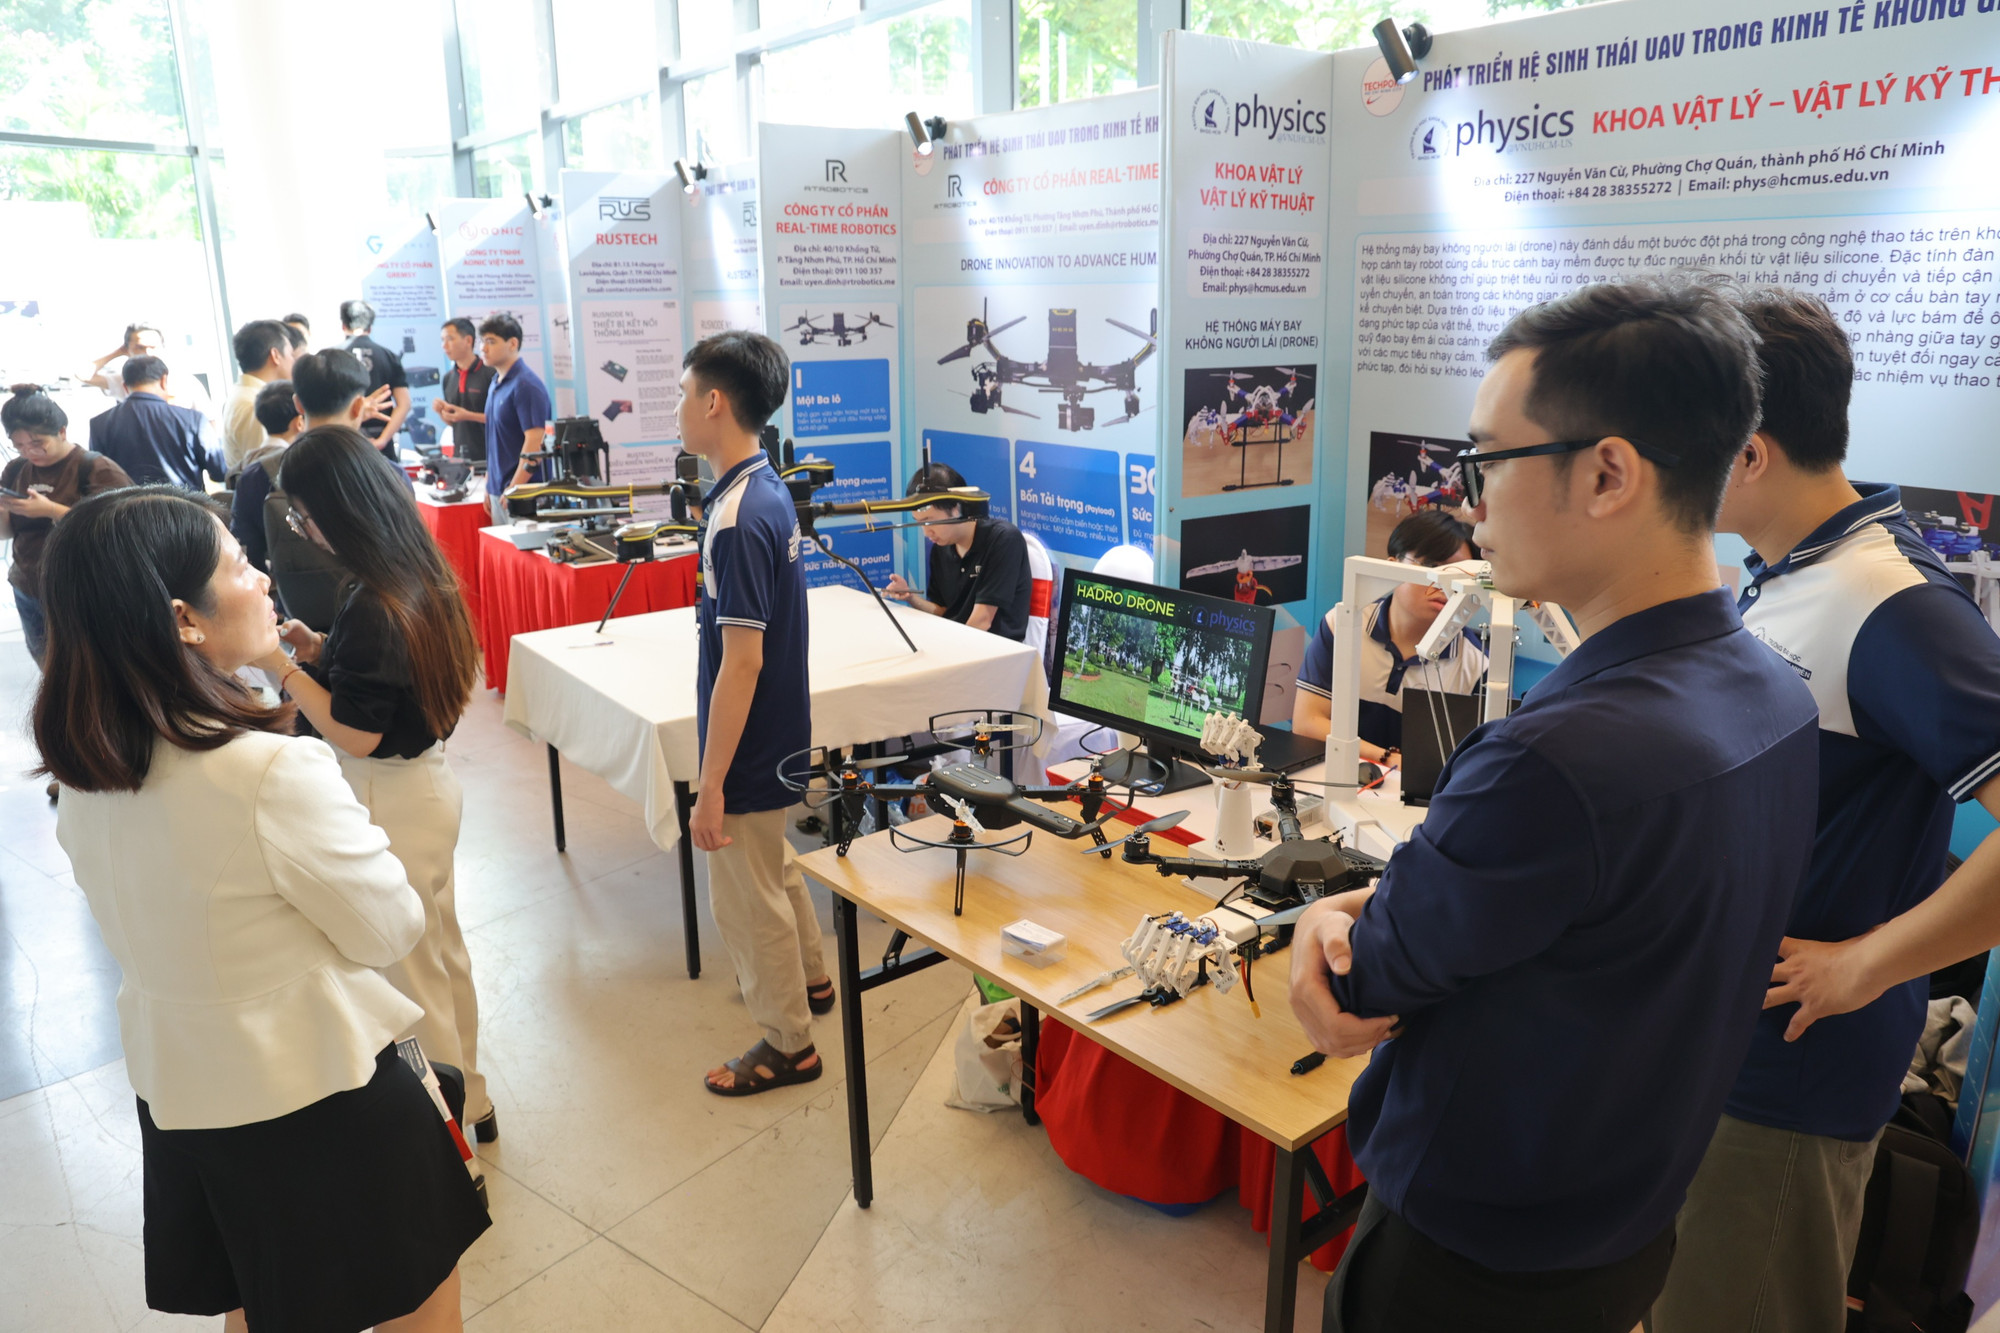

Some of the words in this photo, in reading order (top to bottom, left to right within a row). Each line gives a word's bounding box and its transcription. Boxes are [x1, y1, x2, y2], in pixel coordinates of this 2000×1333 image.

[1424, 64, 1461, 92] PHÁT
[1467, 51, 1512, 86] TRIỂN
[1519, 51, 1540, 82] HỆ
[1546, 47, 1590, 75] SINH
[1596, 36, 1637, 68] THÁI
[1645, 33, 1685, 62] UAV
[1693, 21, 1763, 55] TRONG
[1771, 10, 1829, 44] KINH
[1364, 79, 1401, 92] TECHPO
[1593, 104, 1665, 134] KHOA
[1672, 94, 1723, 131] VẬT
[1730, 88, 1763, 121] LÝ
[1792, 80, 1852, 119] VẬT
[1858, 72, 1898, 108] LÝ
[1904, 65, 1953, 104] KỸ
[1235, 93, 1326, 139] physics
[943, 142, 962, 160] PHÁT
[965, 136, 987, 158] TRIỂN
[990, 137, 1000, 157] HỆ
[1002, 135, 1023, 153] SINH
[1026, 128, 1045, 150] THÁI
[1048, 129, 1066, 147] UAV
[1069, 124, 1099, 144] TRONG
[1103, 120, 1127, 140] KINH
[1130, 112, 1141, 135] TẾ
[1456, 103, 1574, 156] physics
[1215, 162, 1256, 181] KHOA
[1260, 163, 1285, 187] VẬT
[1288, 166, 1303, 184] LÝ
[1494, 173, 1512, 186] chỉ:
[1515, 172, 1535, 184] 227
[1538, 167, 1581, 185] Nguyễn
[1584, 166, 1606, 179] Văn
[1632, 161, 1682, 178] Phường
[1686, 158, 1713, 174] Chợ
[1715, 155, 1757, 172] Quán,
[1761, 150, 1804, 168] thành
[1809, 145, 1840, 167] phố
[1844, 144, 1866, 161] Hồ
[1870, 144, 1897, 159] Chí
[1901, 140, 1945, 157] Minh
[984, 175, 1015, 196] CÔNG
[1017, 177, 1030, 192] TY
[1033, 170, 1049, 191] CỔ
[1052, 165, 1087, 188] PHẦN
[1090, 162, 1159, 186] REAL-TIME
[1504, 190, 1529, 204] Điện
[1532, 187, 1564, 202] thoại:
[1567, 186, 1589, 198] +84
[1592, 185, 1607, 197] 28
[1610, 181, 1671, 197] 38355272
[1688, 177, 1730, 192] Email:
[1733, 168, 1889, 191] phys@hcmus.edu.vn
[784, 202, 818, 216] CÔNG
[820, 205, 835, 216] TY
[838, 202, 854, 217] CỔ
[857, 203, 888, 217] PHẦN
[1200, 186, 1227, 211] VẬT
[1231, 189, 1246, 208] LÝ
[1250, 190, 1268, 209] KỸ
[1271, 192, 1315, 215] THUẬT
[596, 233, 658, 245] RUSTECH
[776, 222, 838, 234] REAL-TIME
[841, 223, 897, 235] ROBOTICS
[1203, 233, 1217, 246] Địa
[1218, 233, 1232, 245] chỉ:
[1234, 235, 1249, 245] 227
[1251, 234, 1281, 248] Nguyễn
[1362, 244, 1374, 256] Hệ
[1376, 242, 1400, 257] thống
[1403, 244, 1420, 256] máy
[1424, 243, 1440, 256] bay
[1442, 242, 1470, 256] không
[1505, 241, 1517, 252] lái
[1519, 240, 1557, 252] (drone)
[1560, 240, 1579, 253] này
[1582, 238, 1610, 250] đánh
[1613, 235, 1634, 249] dấu
[1638, 236, 1660, 251] một
[1664, 235, 1697, 248] bước
[1700, 234, 1720, 250] đột
[1723, 234, 1748, 249] phá
[1752, 233, 1786, 248] trong
[1790, 232, 1825, 248] công
[1830, 230, 1867, 247] nghệ
[1871, 229, 1905, 243] thao
[1910, 228, 1934, 242] tác
[1939, 227, 1970, 241] trên
[961, 257, 992, 271] DRONE
[995, 255, 1054, 270] INNOVATION
[1058, 255, 1071, 268] TO
[1074, 252, 1126, 268] ADVANCE
[1130, 251, 1158, 267] HUM
[1188, 249, 1221, 262] Phường
[1222, 250, 1239, 263] Chợ
[1240, 251, 1263, 262] Quán,
[1265, 252, 1275, 261] TP.
[1277, 250, 1287, 262] Hồ
[1289, 251, 1301, 262] Chí
[1302, 252, 1321, 263] Minh
[1200, 266, 1219, 279] Điện
[1221, 266, 1244, 279] thoại:
[1245, 267, 1260, 277] +84
[1262, 267, 1271, 277] 28
[1273, 268, 1310, 278] 38355272
[1202, 282, 1227, 292] Email:
[1229, 282, 1306, 295] phys@hcmus.edu.vn
[1205, 318, 1219, 335] HỆ
[1222, 317, 1257, 332] THỐNG
[1260, 317, 1281, 331] MÁY
[1283, 320, 1302, 331] BAY
[1185, 335, 1223, 350] KHÔNG
[1226, 333, 1259, 349] NGƯỜI
[1262, 333, 1277, 347] LÁI
[1279, 336, 1318, 350] (DRONE)
[1019, 451, 1037, 478] 4
[1020, 489, 1038, 504] Bốn
[1040, 491, 1055, 507] Tải
[1057, 495, 1084, 514] trọng
[1085, 504, 1115, 518] (Payload)
[1132, 506, 1153, 522] Sức
[861, 553, 890, 566] pound
[1077, 584, 1124, 605] HADRO
[1127, 594, 1176, 617] DRONE
[1209, 610, 1256, 633] physics
